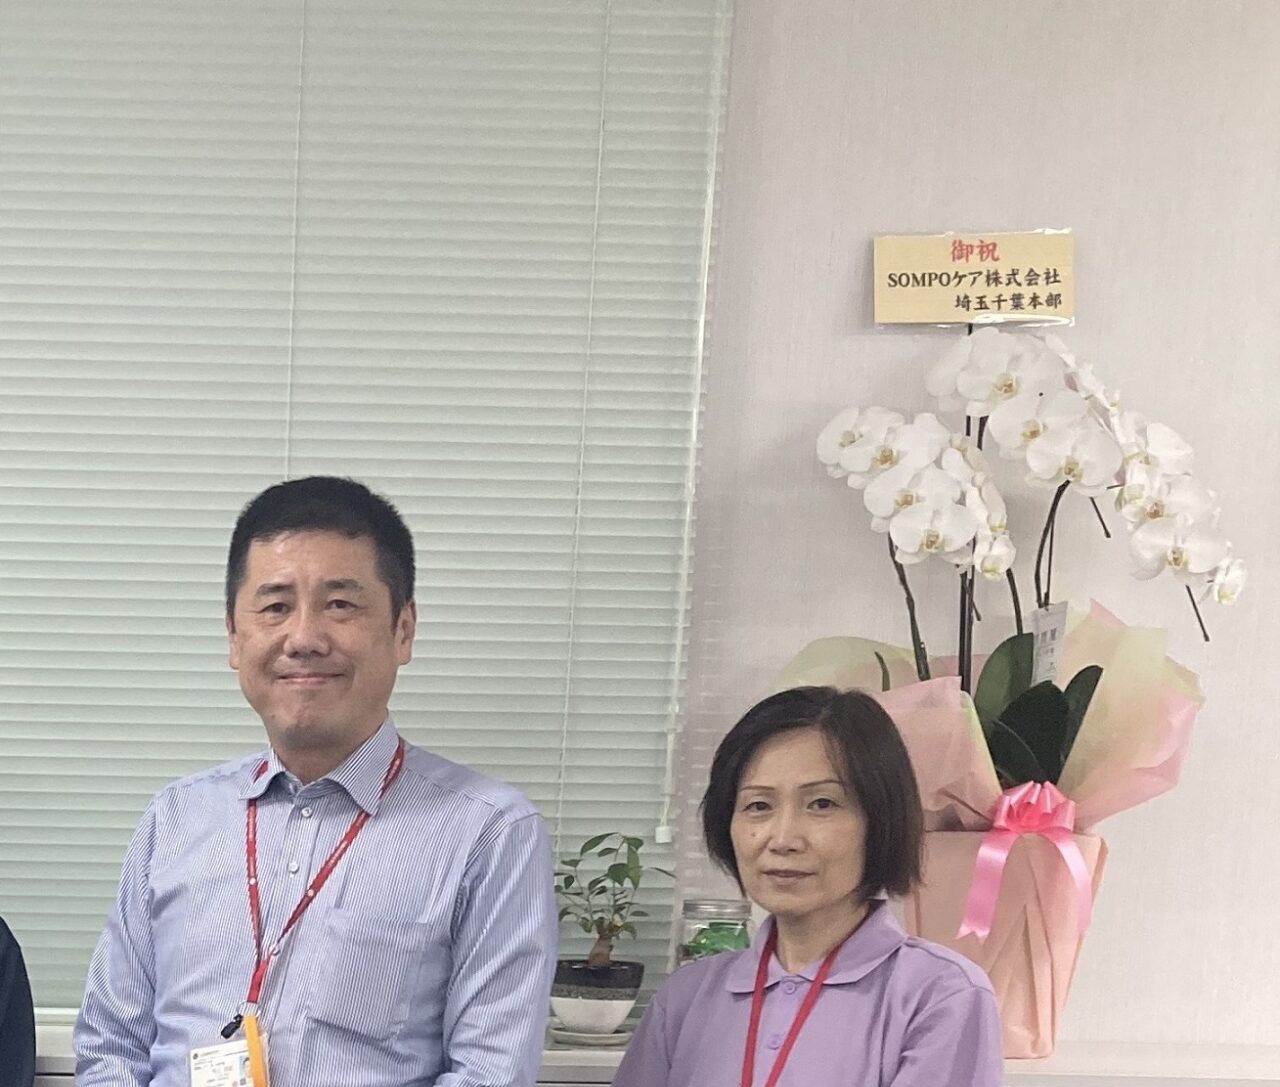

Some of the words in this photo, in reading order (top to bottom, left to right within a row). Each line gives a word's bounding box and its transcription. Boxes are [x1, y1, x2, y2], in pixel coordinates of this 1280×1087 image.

[951, 239, 1000, 263] 御祝
[887, 267, 1062, 288] SOMPOケア株式会社
[954, 292, 1062, 312] 埼玉千葉本部
